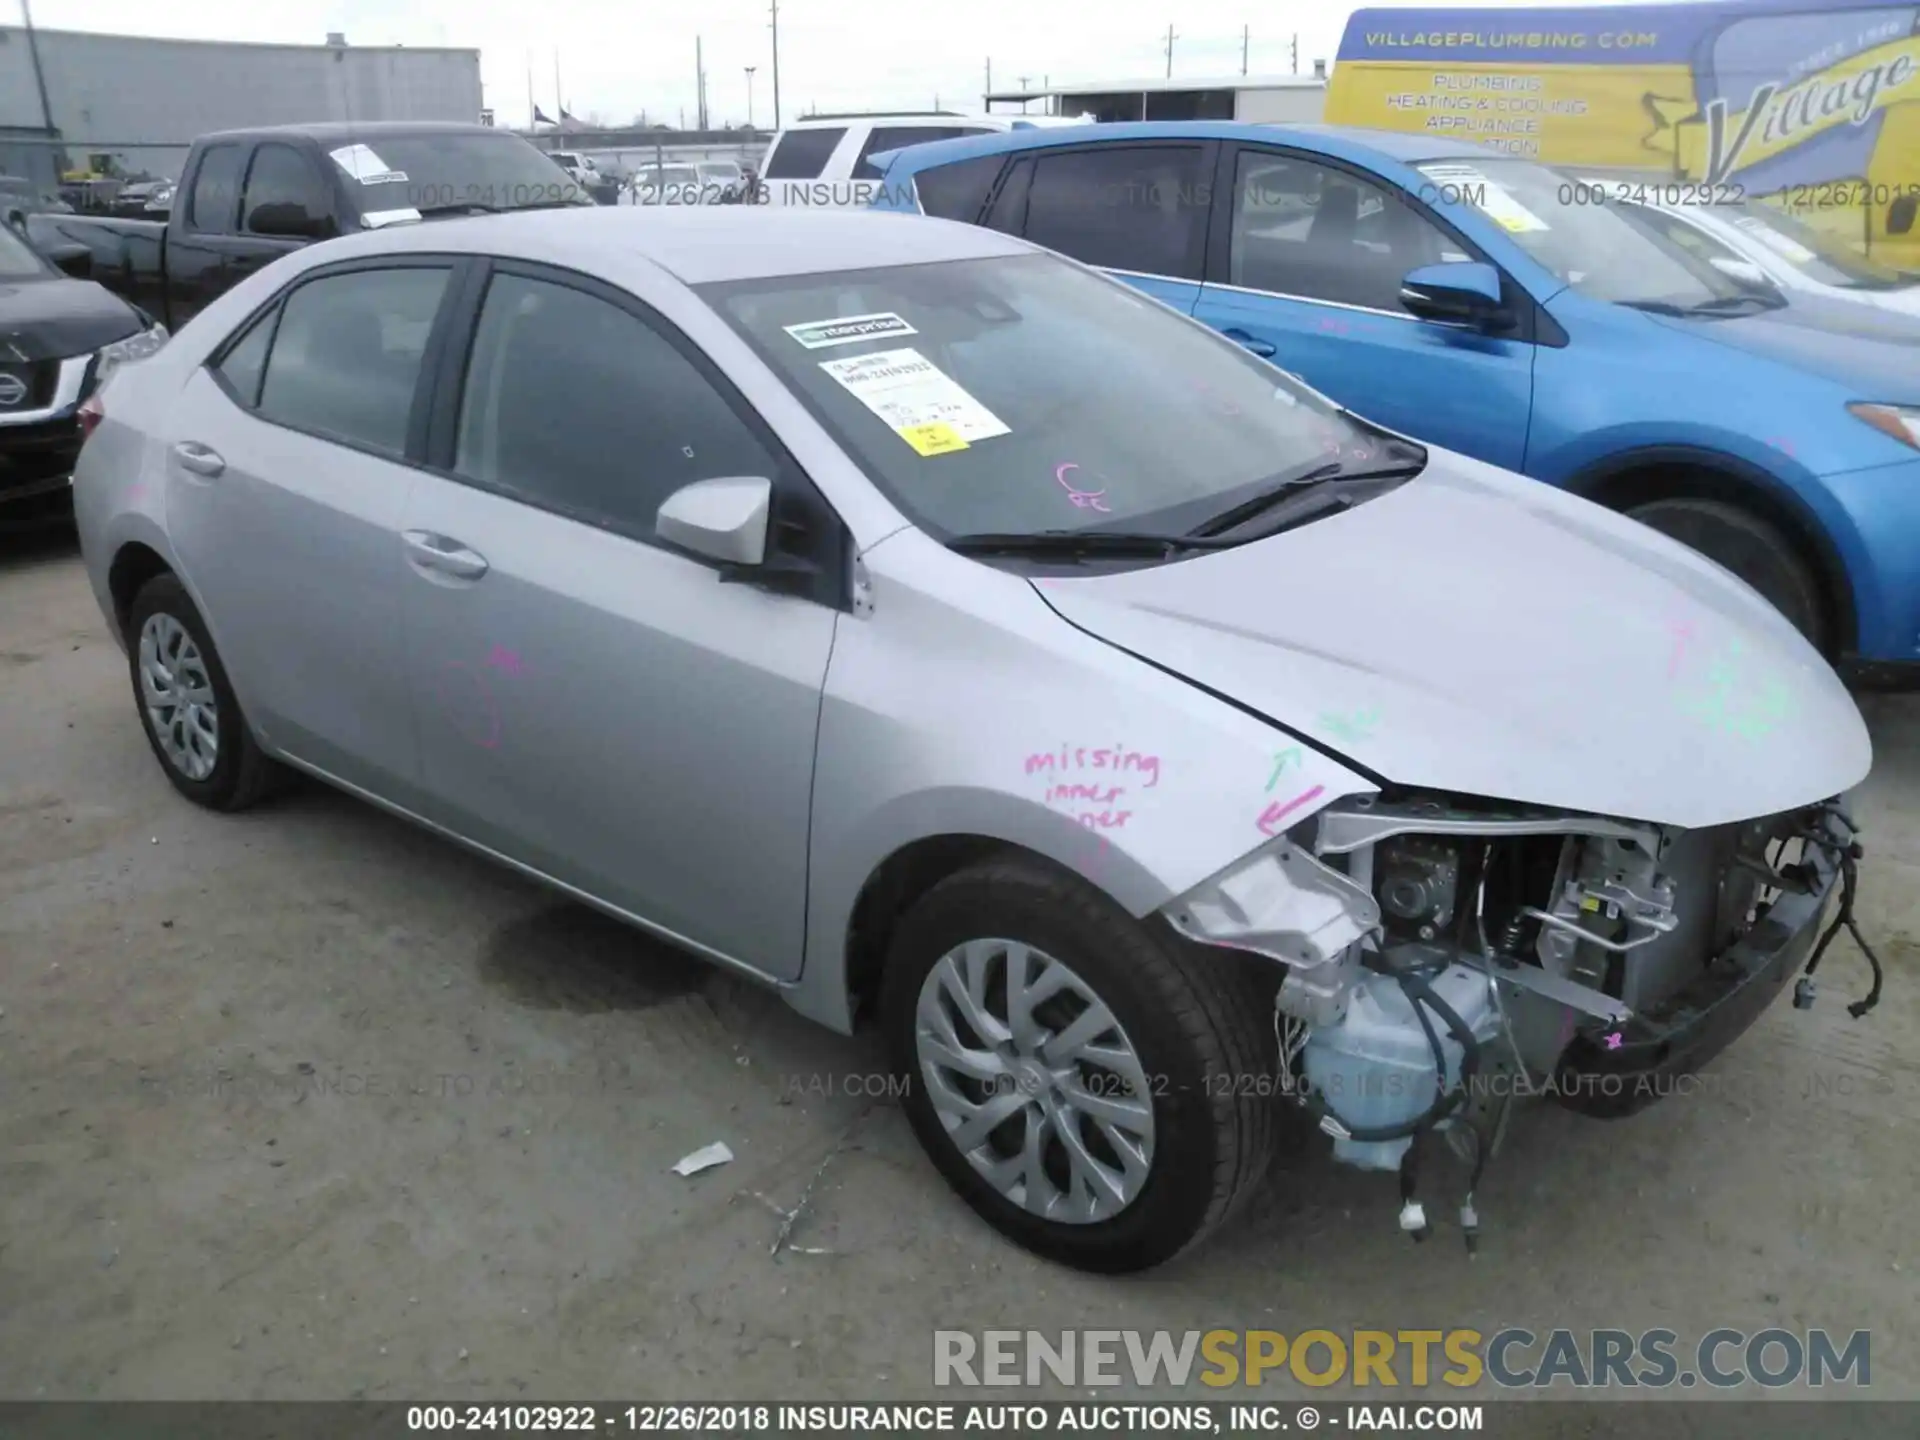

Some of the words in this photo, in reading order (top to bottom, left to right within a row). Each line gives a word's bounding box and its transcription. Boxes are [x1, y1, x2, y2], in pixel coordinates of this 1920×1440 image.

[1433, 73, 1542, 91] PLUMBING
[1386, 94, 1473, 111] HEATING
[1494, 97, 1590, 114] COOLING
[1424, 115, 1540, 133] APPLIANCE
[1705, 54, 1913, 186] Village
[1024, 742, 1161, 788] missing
